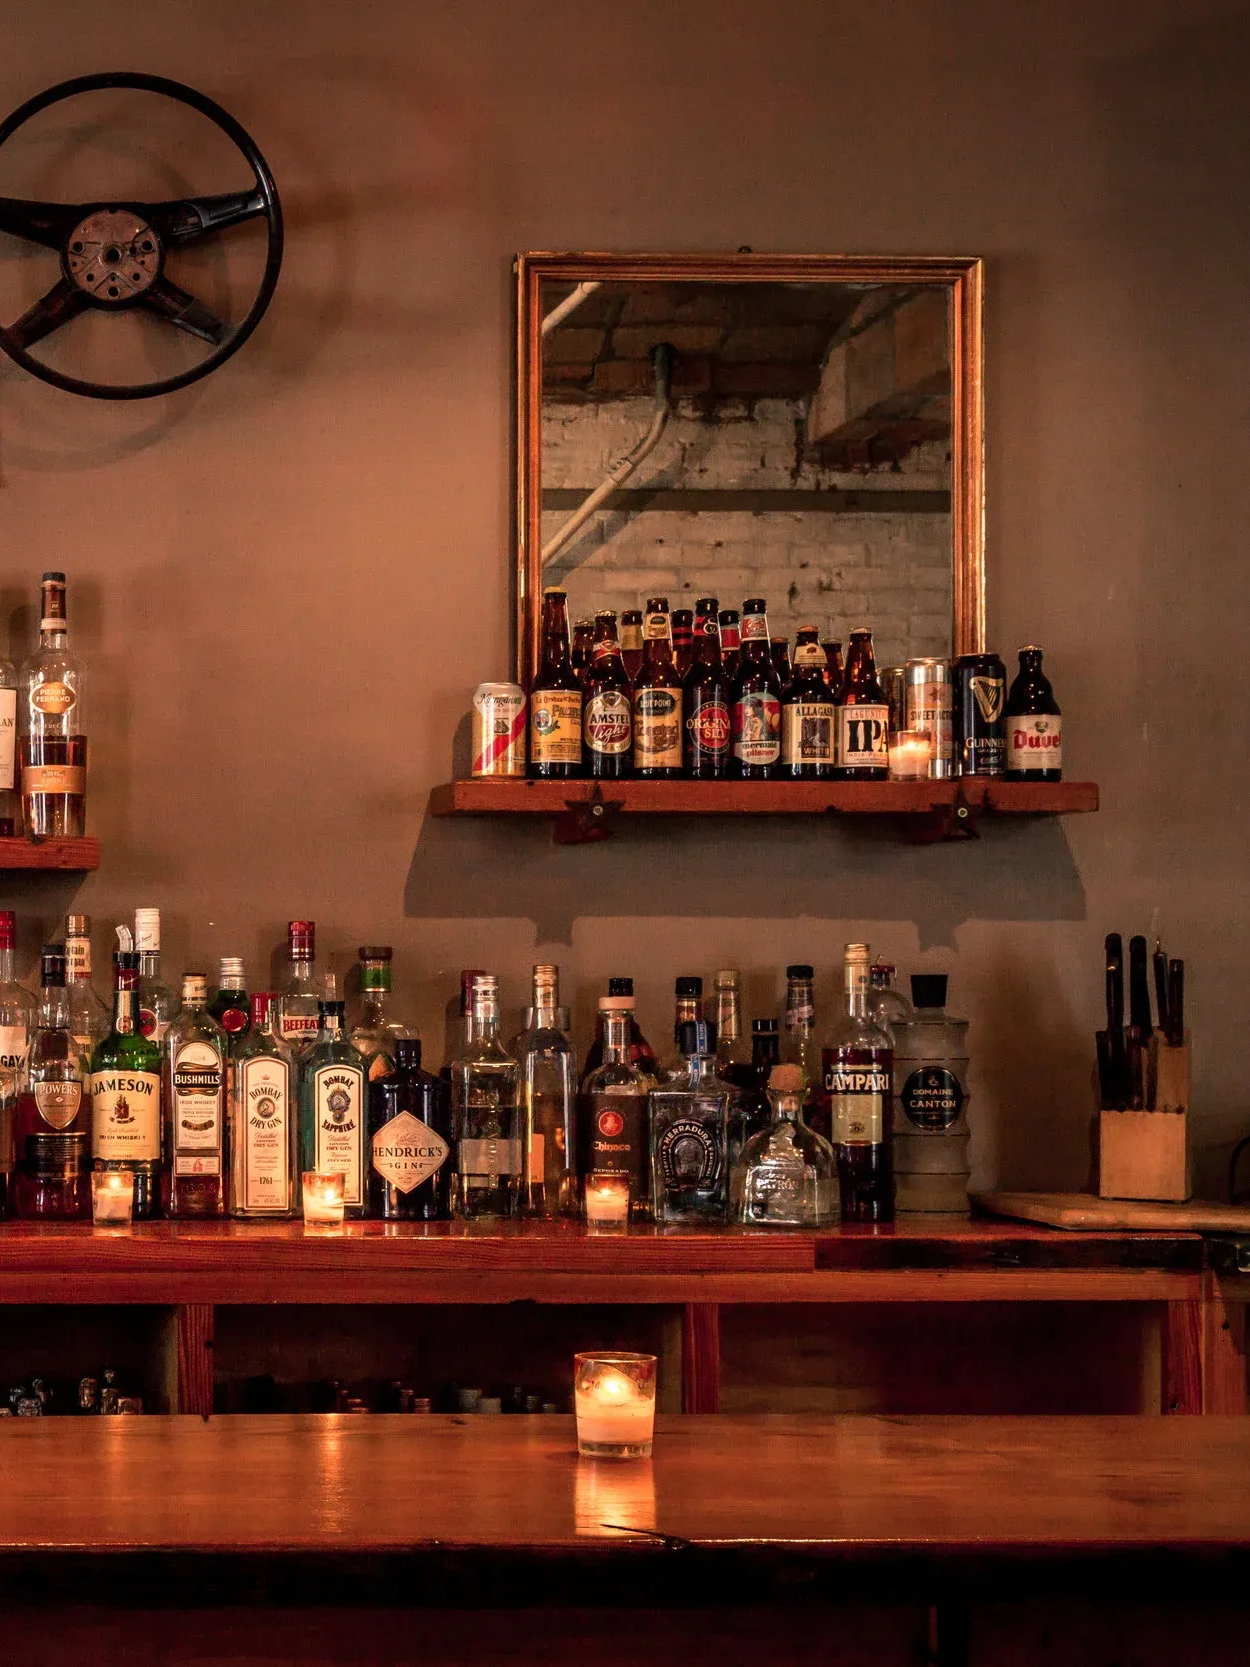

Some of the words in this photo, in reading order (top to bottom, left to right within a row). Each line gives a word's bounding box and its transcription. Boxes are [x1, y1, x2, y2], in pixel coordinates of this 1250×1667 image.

[654, 699, 671, 708] POINT
[590, 713, 630, 724] AMSTEL
[846, 719, 889, 753] IPA
[283, 1020, 319, 1031] BEEFEAT
[174, 1074, 220, 1084] BUSHMILLS
[323, 1075, 354, 1090] BOMBAY
[825, 1074, 889, 1091] CAMPARI
[39, 1084, 78, 1096] POWERS
[93, 1078, 153, 1096] JAMESON
[249, 1087, 283, 1101] BOMBAY
[910, 1100, 956, 1108] CANTON
[250, 1117, 266, 1130] DRY
[267, 1117, 282, 1130] GIN
[321, 1119, 357, 1133] SAPPHIRE
[664, 1124, 712, 1146] HERRADURA
[373, 1146, 443, 1157] HENDRICK'S
